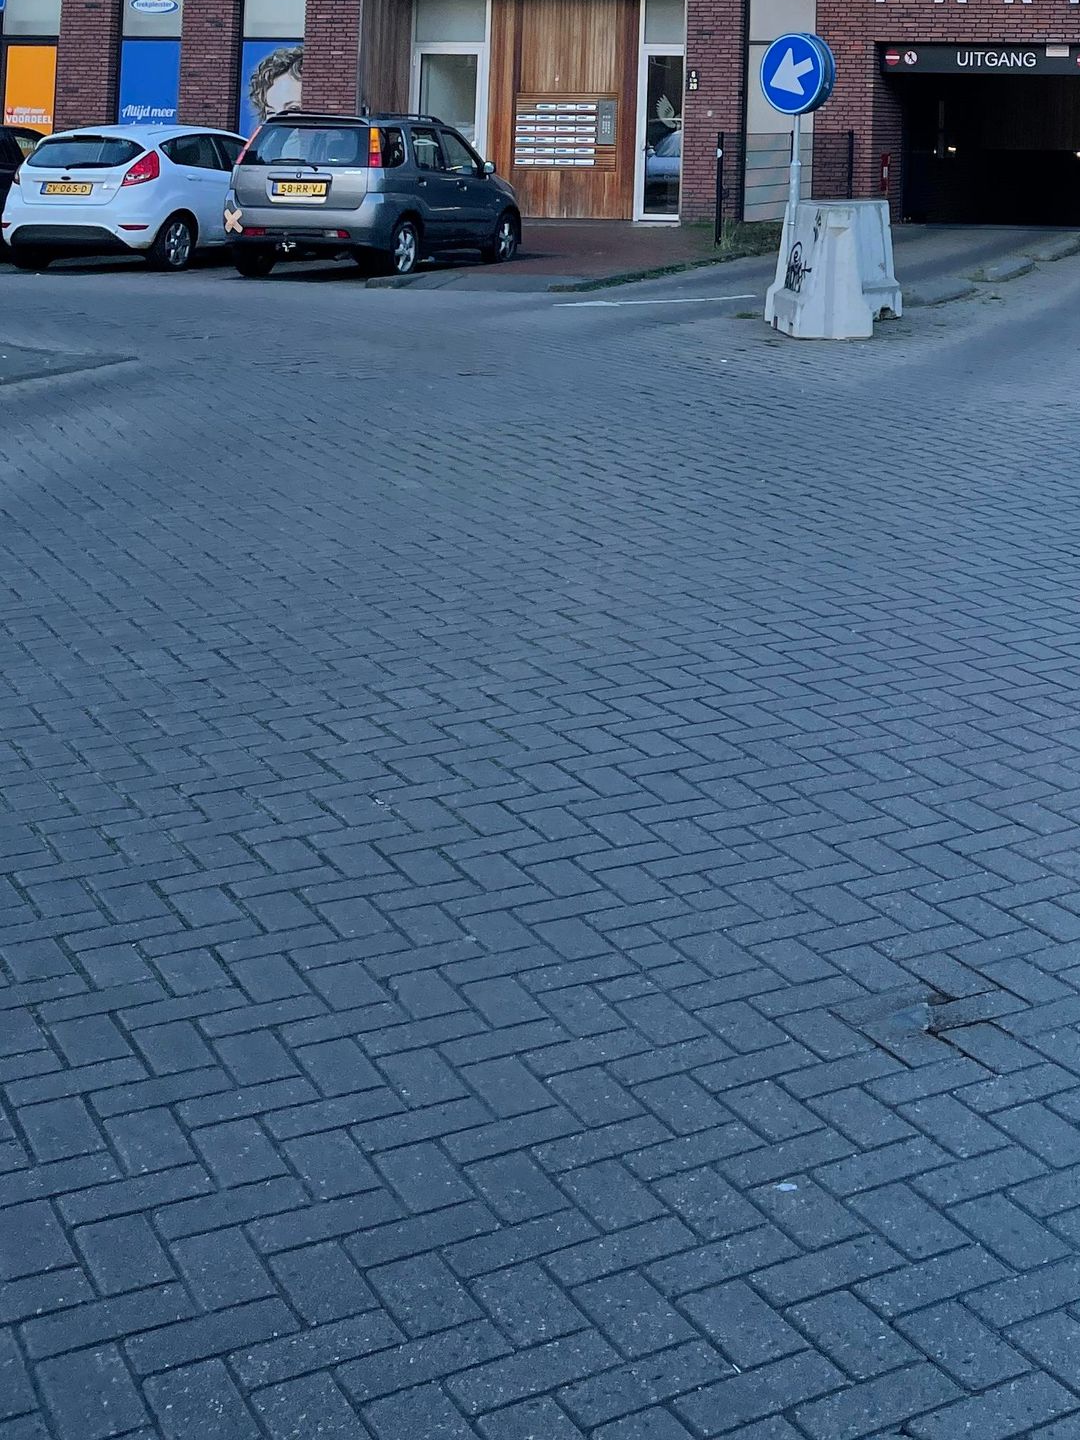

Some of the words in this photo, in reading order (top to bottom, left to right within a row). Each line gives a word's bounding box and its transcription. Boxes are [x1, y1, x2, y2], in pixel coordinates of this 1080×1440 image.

[957, 51, 1037, 67] UITGANG
[6, 115, 52, 124] VOORDEEL
[122, 104, 151, 120] Altijd
[151, 108, 177, 117] meer
